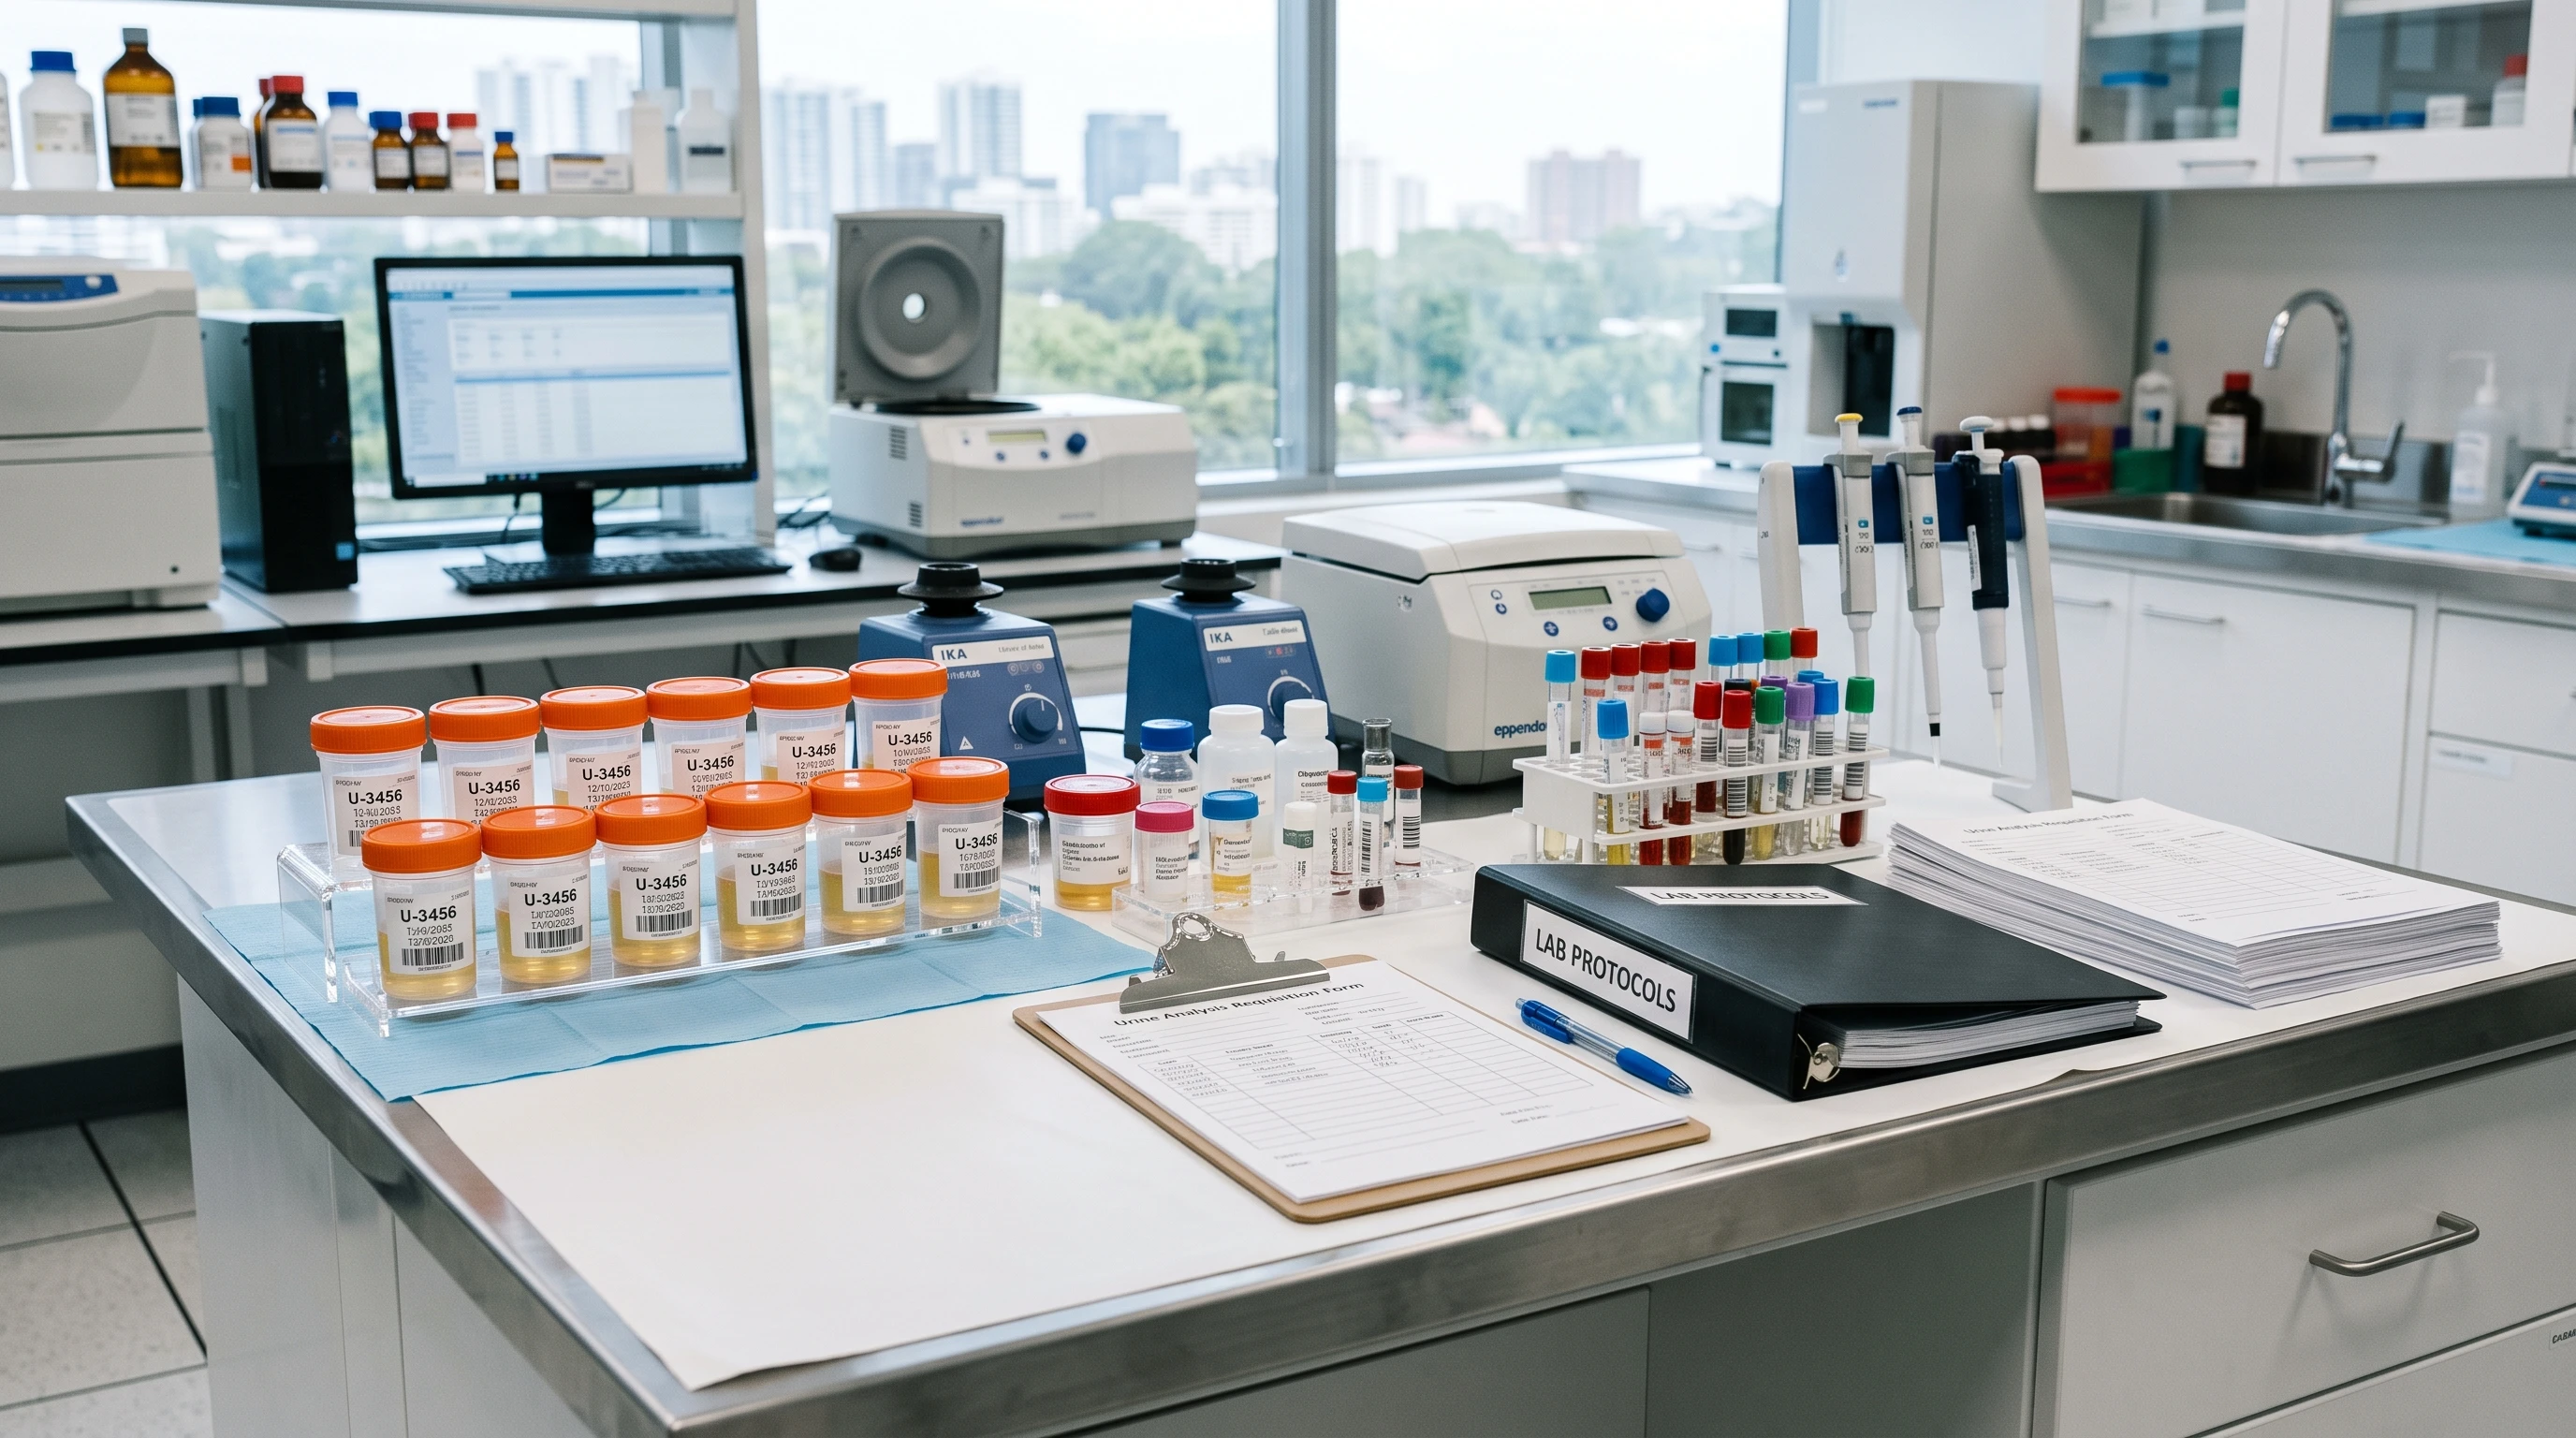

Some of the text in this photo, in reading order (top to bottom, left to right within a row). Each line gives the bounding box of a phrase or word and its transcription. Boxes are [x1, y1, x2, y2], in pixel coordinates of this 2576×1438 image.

[1209, 632, 1233, 644] IKA
[941, 649, 968, 661] IKA
[1494, 720, 1547, 739] eppendo
[888, 731, 932, 746] U-3456
[792, 742, 837, 758] U-3456
[687, 755, 735, 771] U-3456
[582, 765, 631, 781] U-3456
[468, 779, 520, 795] U-3456
[348, 788, 402, 805] U-3456
[956, 832, 998, 850] U-3456
[859, 844, 902, 863] U-3456
[751, 858, 798, 876] U-3456
[636, 873, 687, 890] U-3456
[524, 888, 577, 906] U-3456
[1650, 891, 1698, 900] LAB
[401, 905, 457, 923] U-3456
[1535, 928, 1676, 1013] LAB PROTOCOLS
[1230, 990, 1320, 1008] Requisition
[1322, 983, 1365, 993] Form
